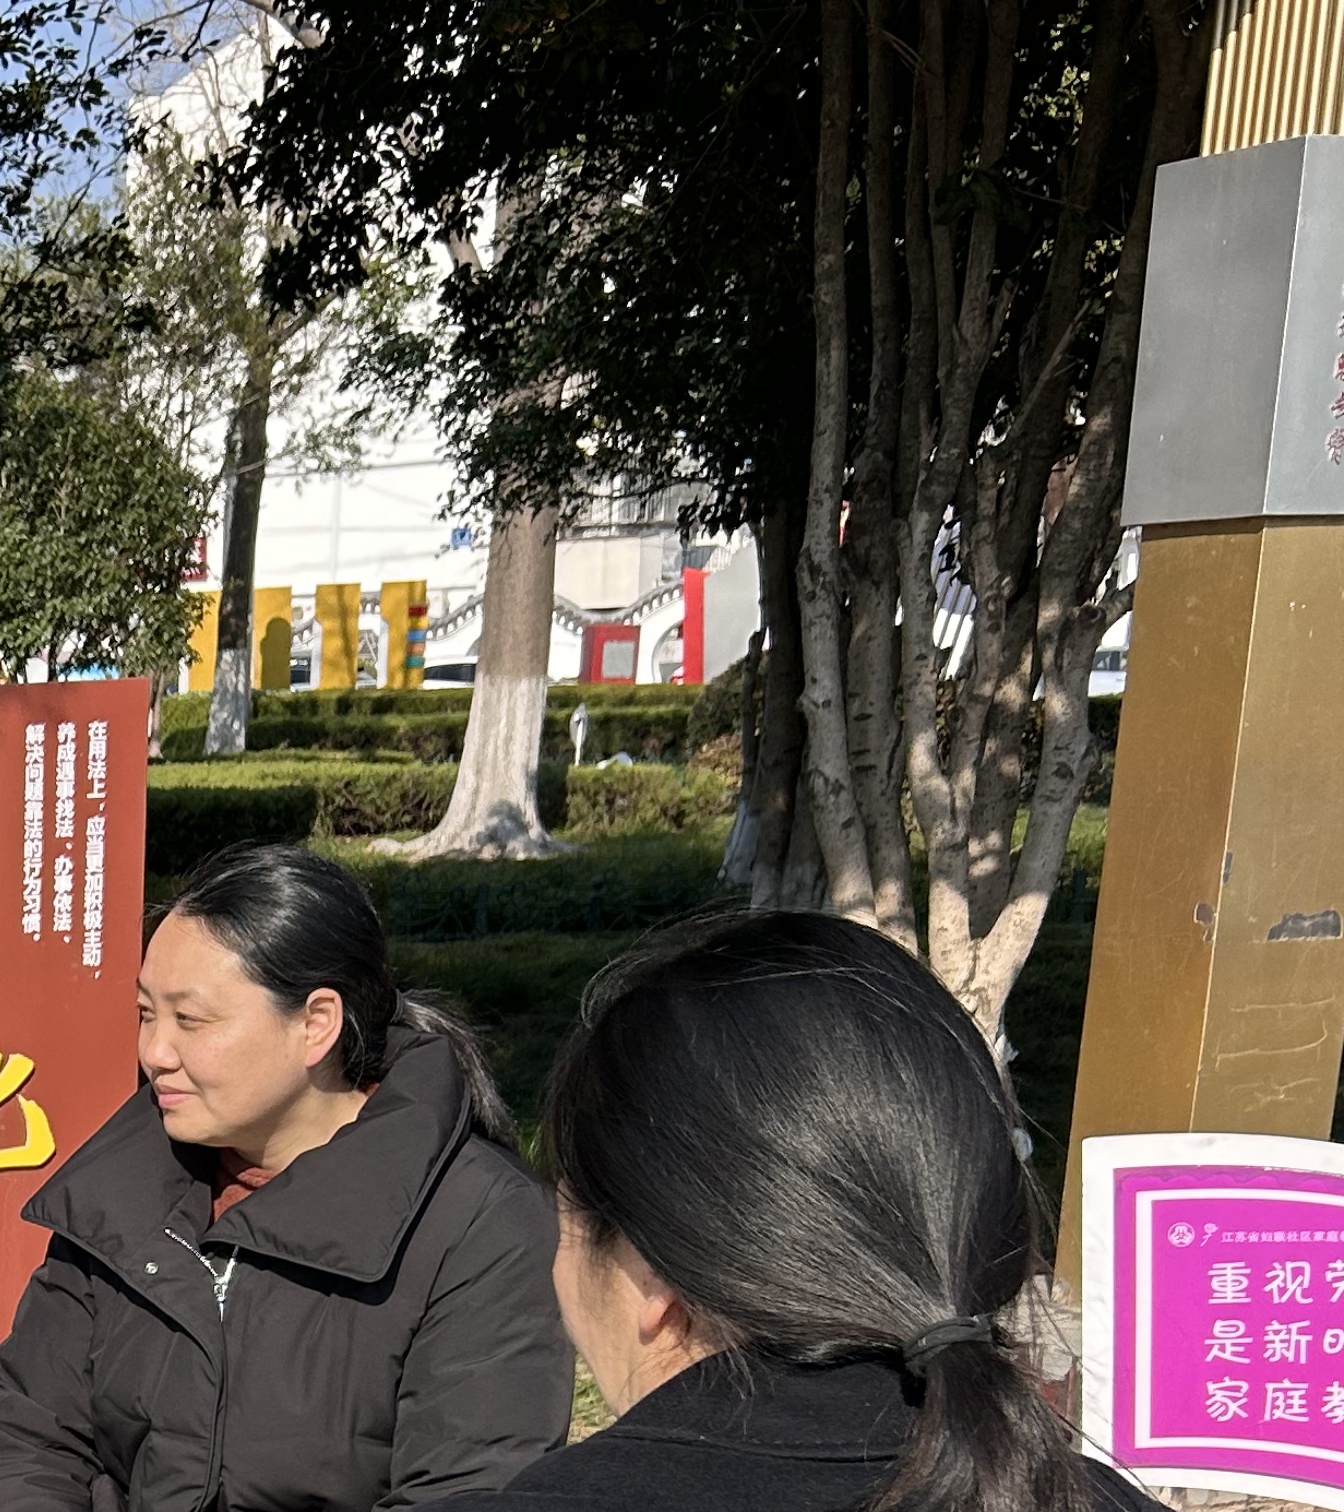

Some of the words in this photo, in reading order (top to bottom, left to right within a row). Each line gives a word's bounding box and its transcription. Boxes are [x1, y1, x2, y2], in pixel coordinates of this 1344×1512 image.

[1221, 1231, 1344, 1243] 江苏省妇联社区家庭
